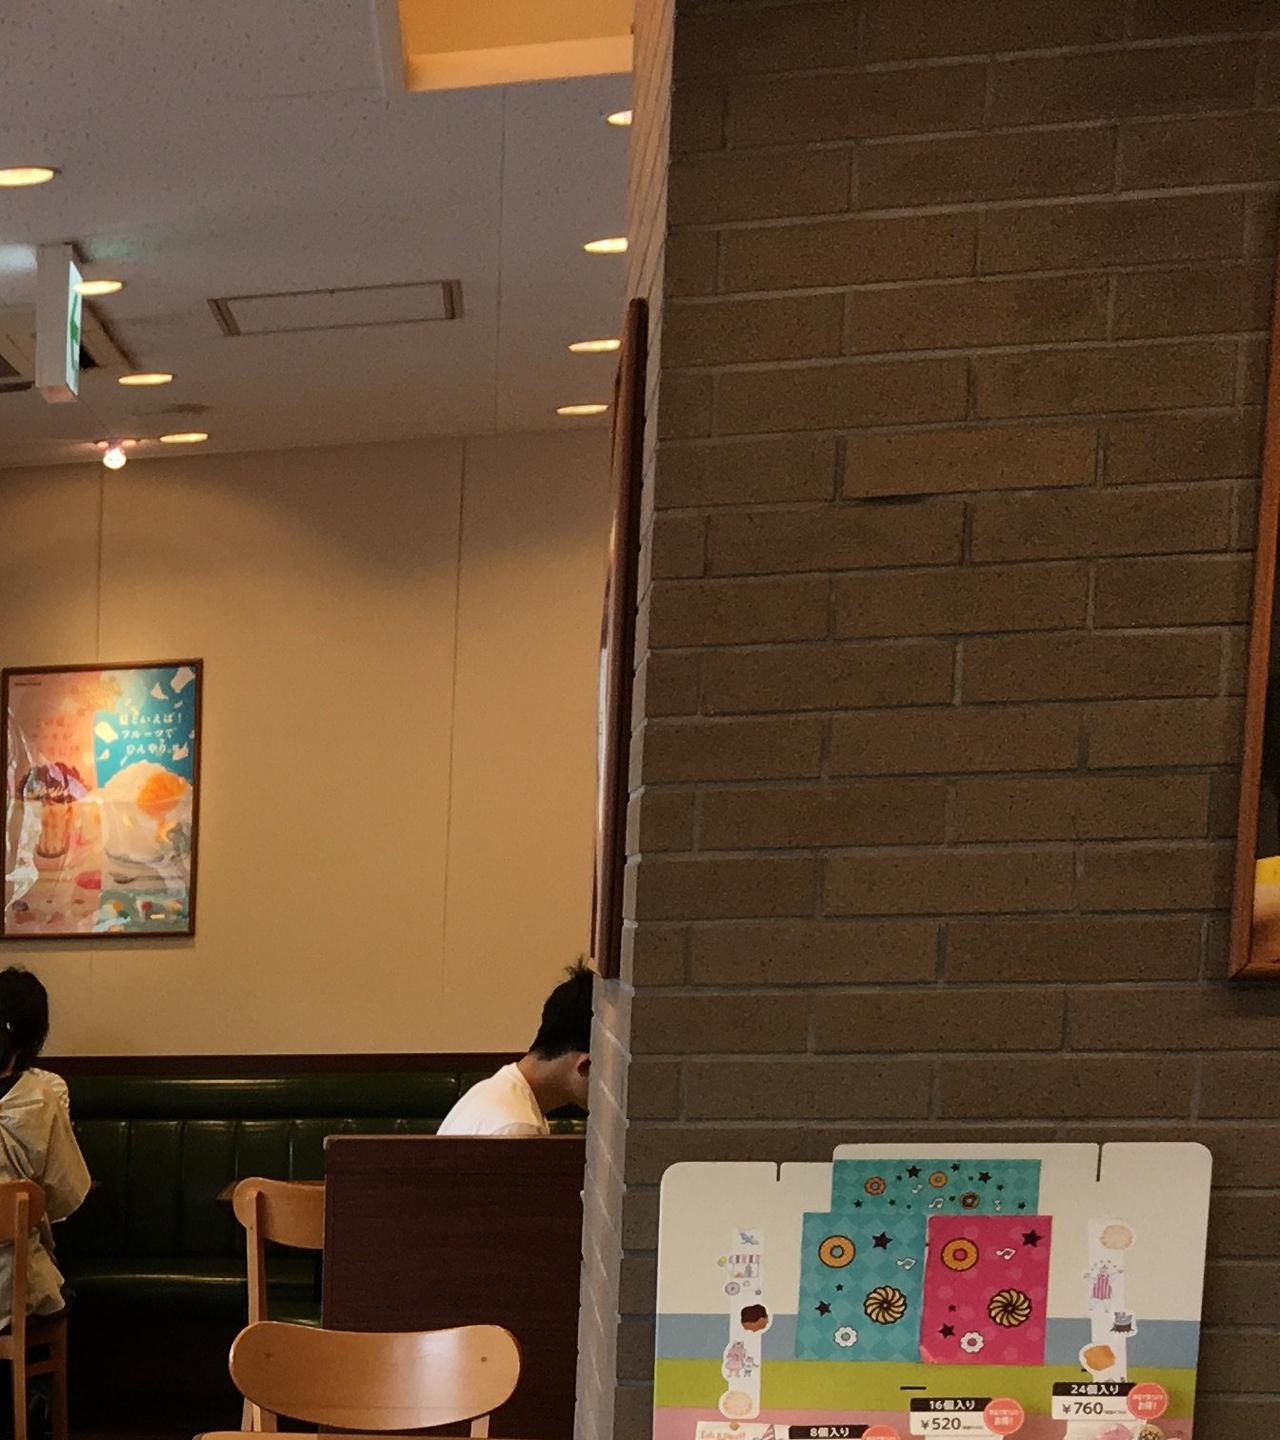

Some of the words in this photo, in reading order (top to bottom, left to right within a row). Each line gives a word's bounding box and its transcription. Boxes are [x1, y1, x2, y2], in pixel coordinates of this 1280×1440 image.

[1070, 1384, 1119, 1395] 24個入り
[929, 1399, 976, 1411] 16個入り
[1062, 1401, 1104, 1415] ¥760
[921, 1416, 962, 1430] ¥520
[810, 1426, 850, 1438] 8個入り
